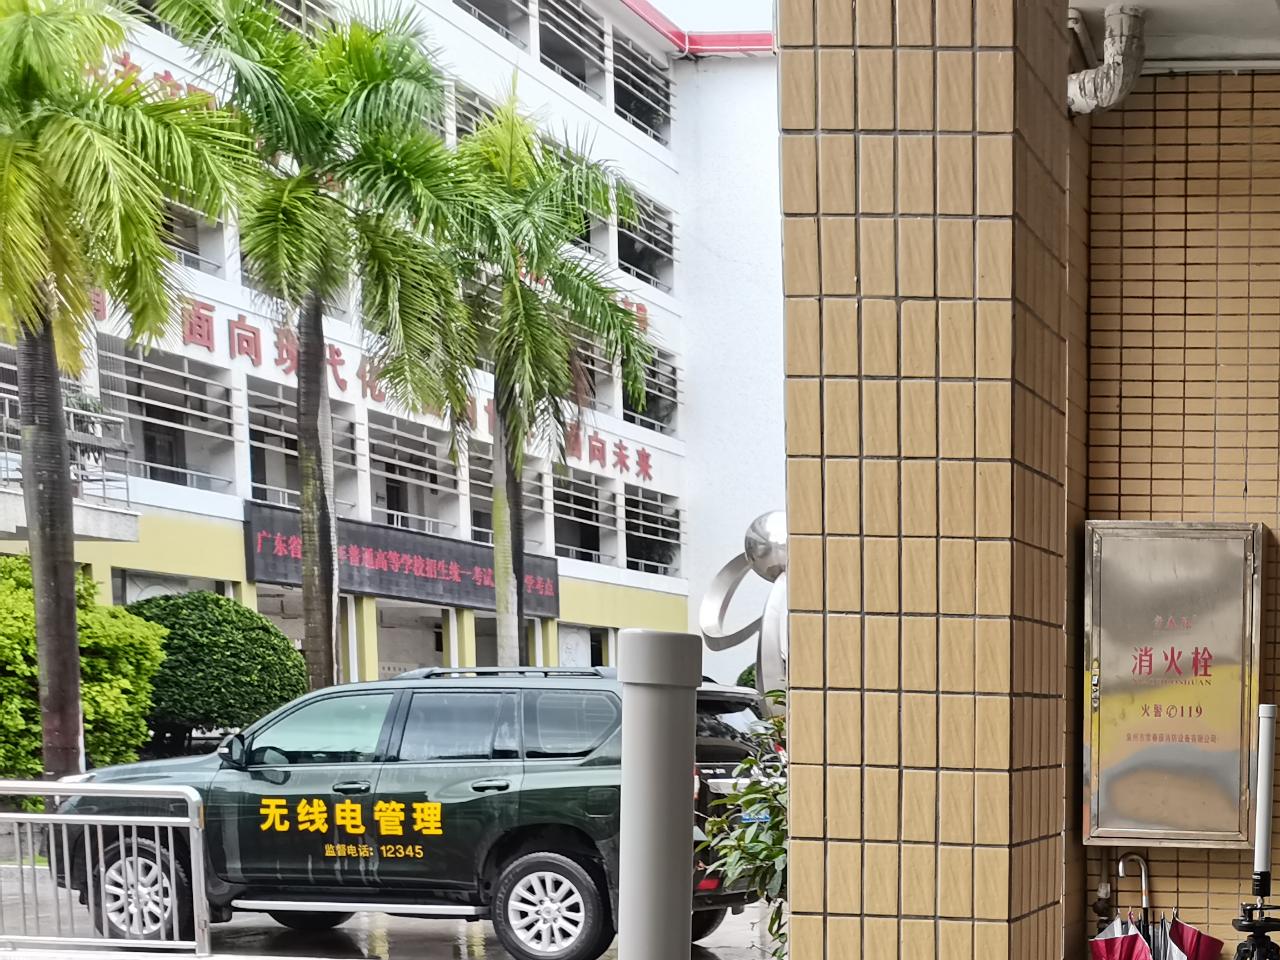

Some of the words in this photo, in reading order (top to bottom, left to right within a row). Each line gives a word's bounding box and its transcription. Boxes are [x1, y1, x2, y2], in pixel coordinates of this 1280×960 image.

[1131, 646, 1213, 677] 消火栓
[1180, 705, 1203, 718] 119
[259, 798, 443, 836] 无线电管理
[380, 844, 424, 859] 12345
